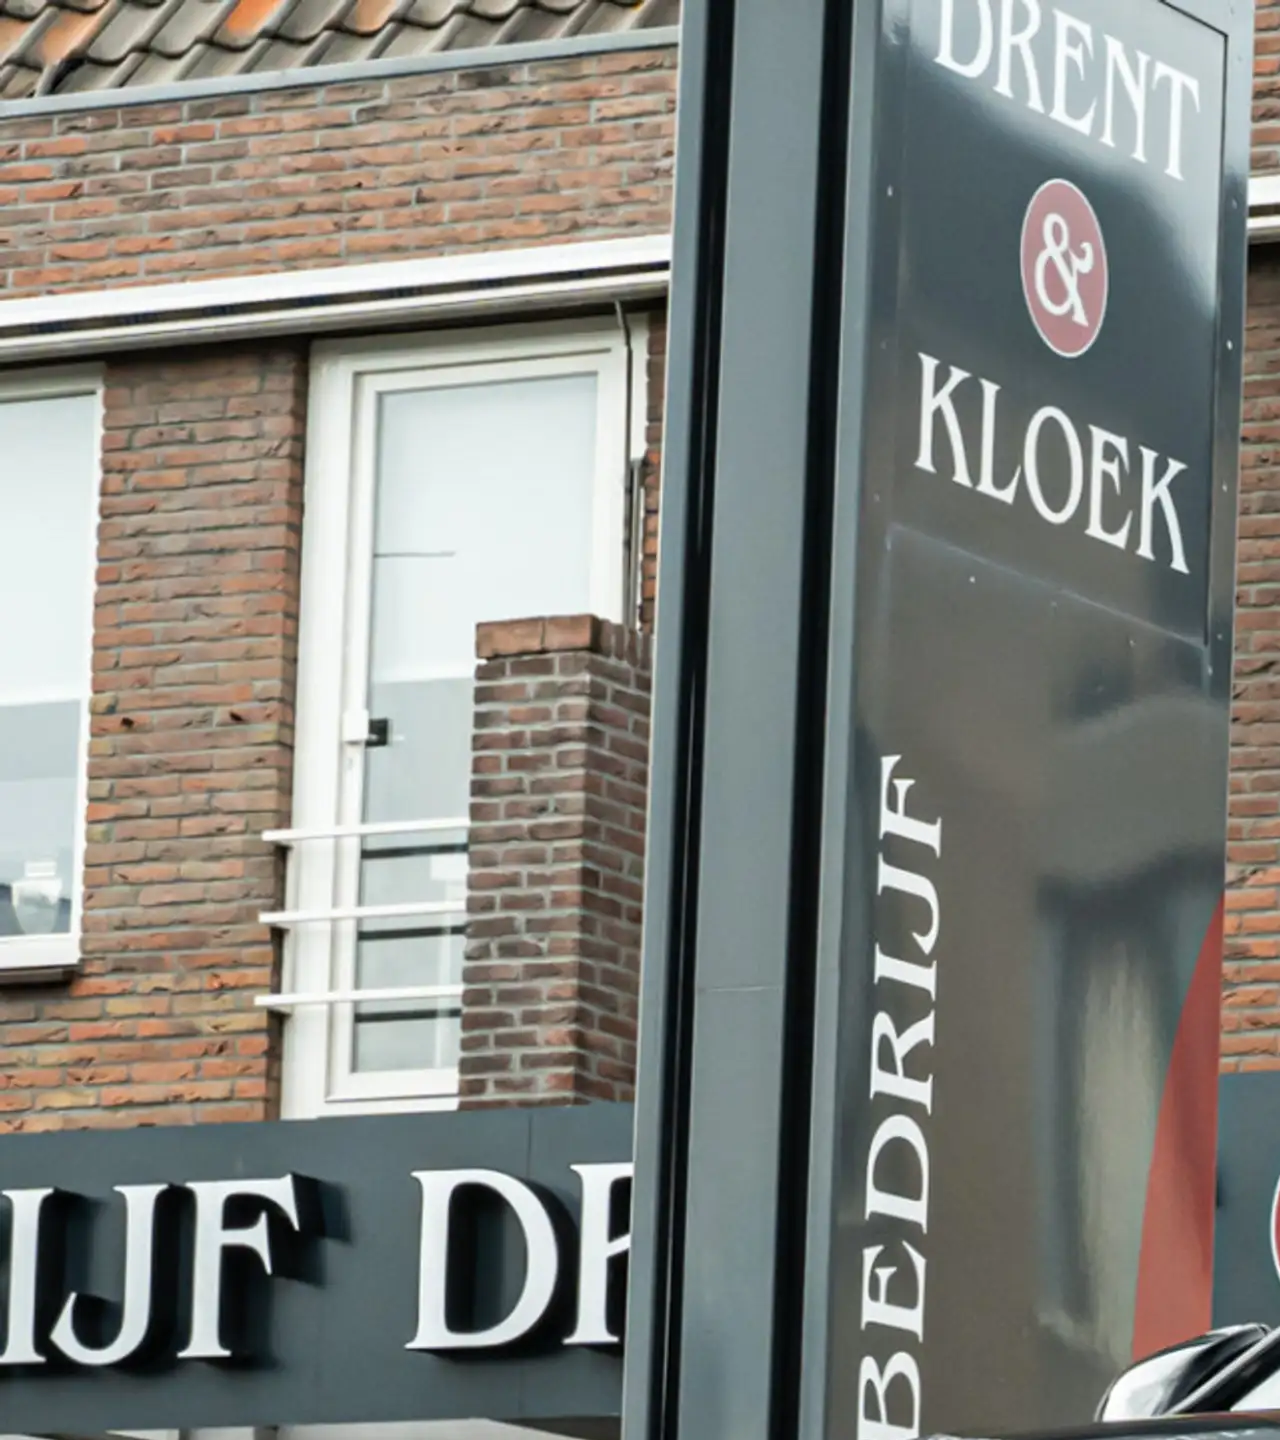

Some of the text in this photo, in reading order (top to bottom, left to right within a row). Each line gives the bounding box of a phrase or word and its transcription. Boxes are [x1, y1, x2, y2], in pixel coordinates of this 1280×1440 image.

[933, 0, 1201, 181] DRENT
[1034, 213, 1093, 327] &
[914, 353, 1190, 574] KLOEK
